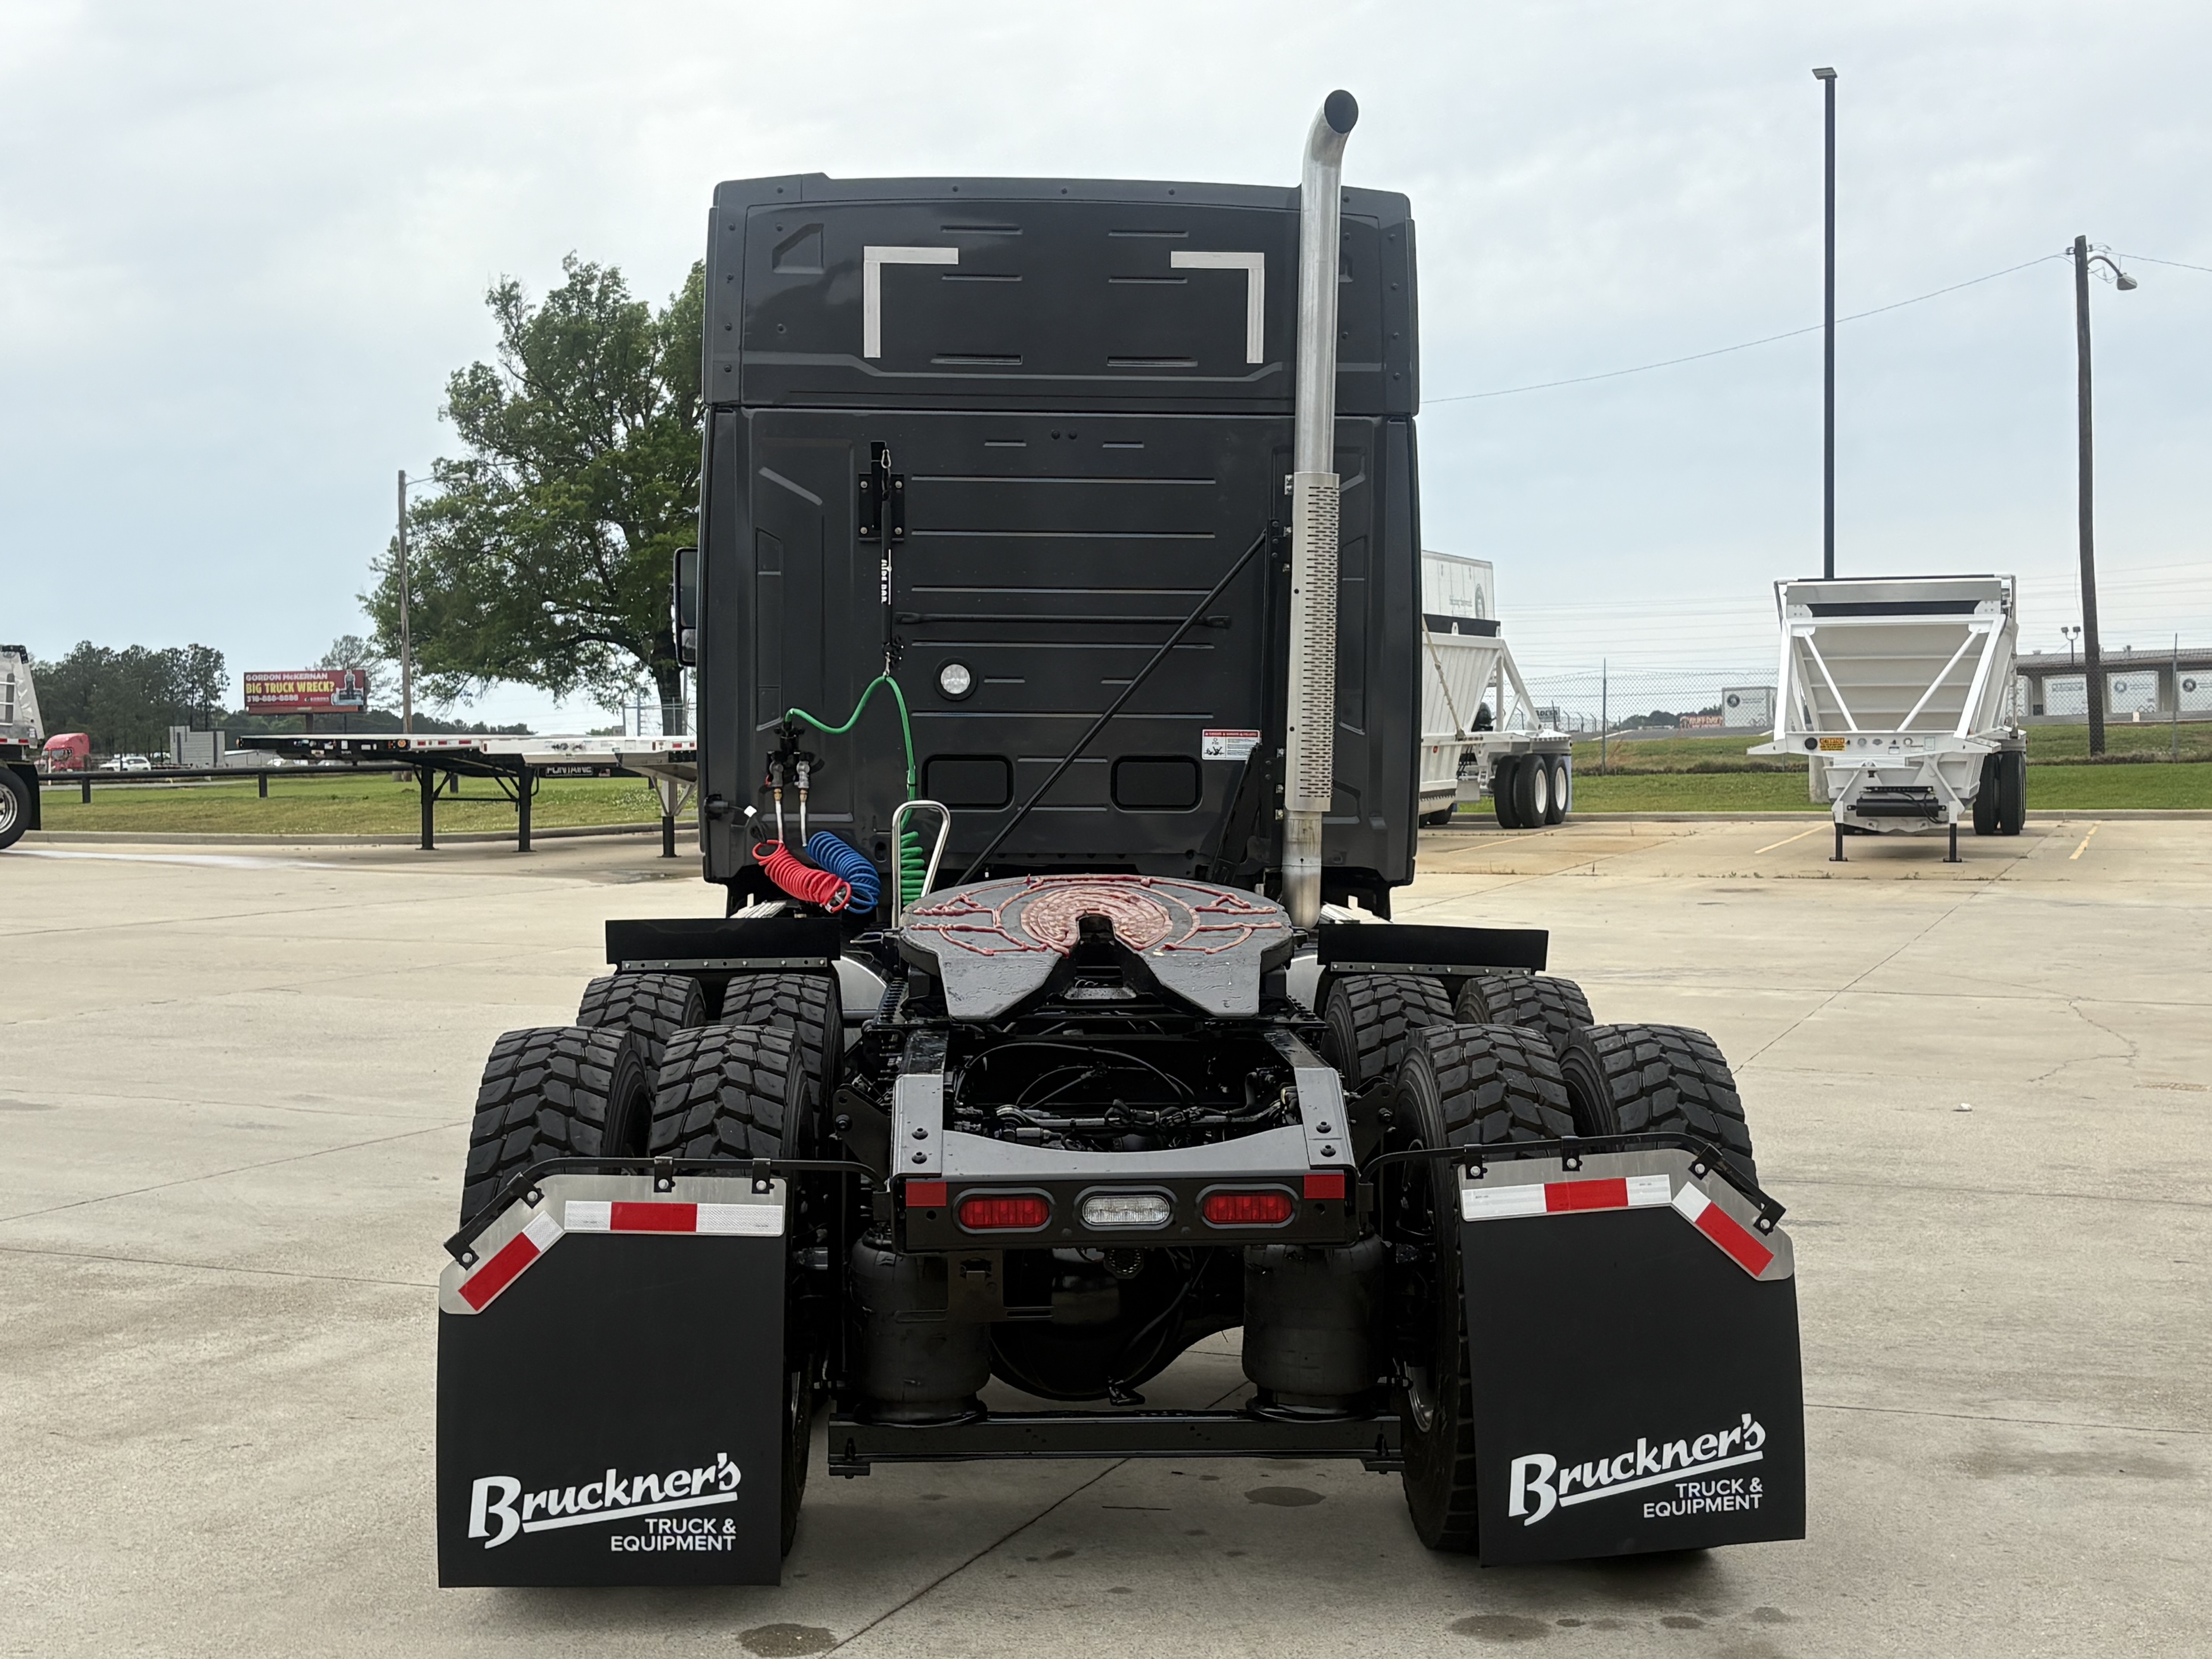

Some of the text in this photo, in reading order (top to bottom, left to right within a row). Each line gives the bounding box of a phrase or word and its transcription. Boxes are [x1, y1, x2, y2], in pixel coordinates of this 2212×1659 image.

[283, 673, 328, 681] McKERNAN
[246, 681, 335, 694] BIG TRUCK WRECK?
[1509, 1413, 1765, 1526] Bruckner's
[1675, 1477, 1763, 1498] TRUCK &
[468, 1453, 741, 1549] Bruckner's
[1644, 1494, 1762, 1518] EQUIPMENT
[645, 1518, 736, 1534] TRUCK &
[611, 1535, 736, 1551] EQUIPMENT
